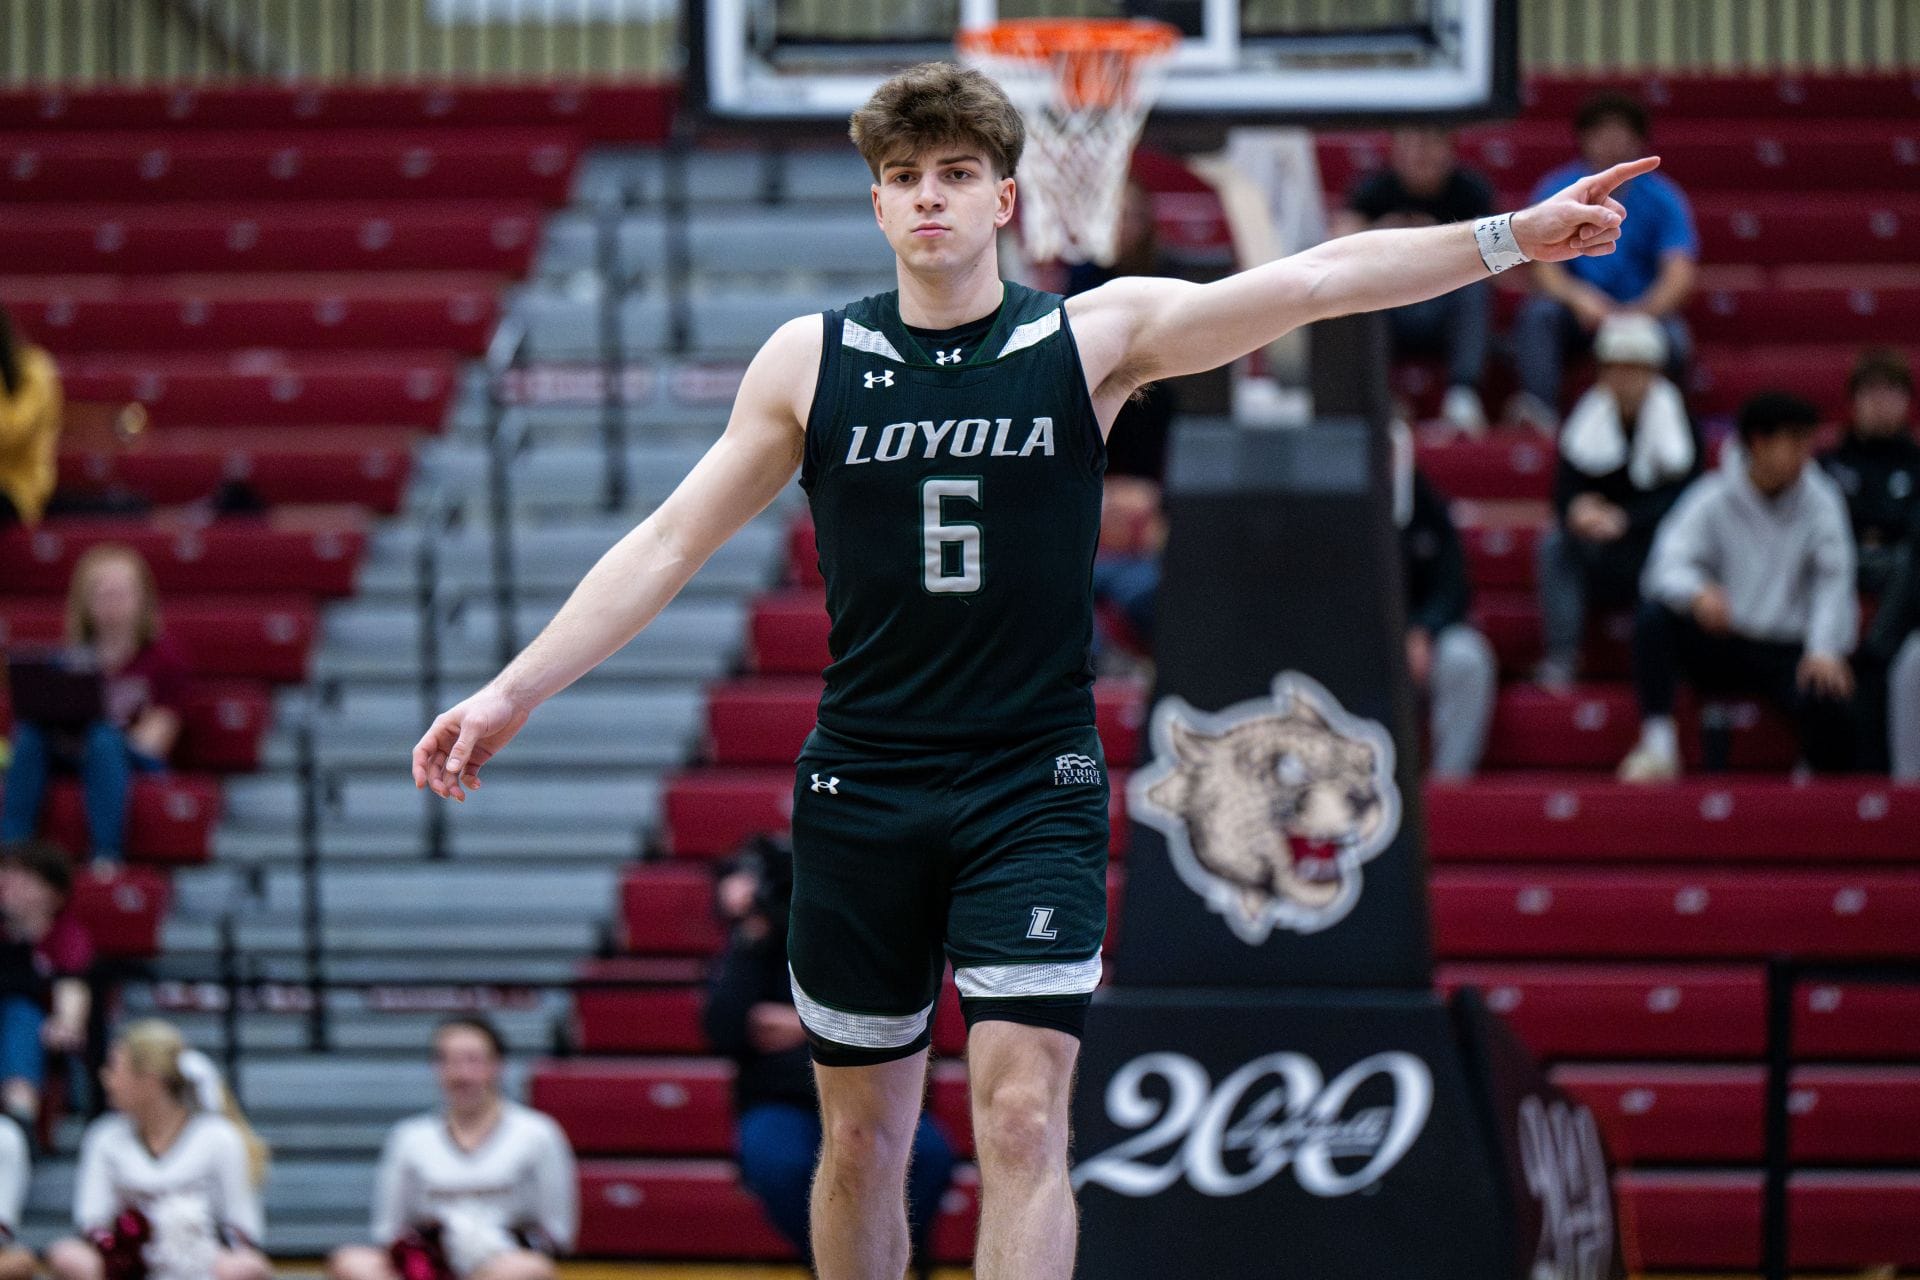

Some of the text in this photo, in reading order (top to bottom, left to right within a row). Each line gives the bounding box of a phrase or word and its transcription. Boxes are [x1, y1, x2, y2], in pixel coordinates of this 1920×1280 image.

[845, 417, 1055, 465] LOYOLA
[923, 477, 983, 595] 6
[1053, 768, 1101, 778] PATRIOT
[1054, 776, 1102, 786] LEAGUE
[1026, 906, 1058, 940] L
[1070, 1050, 1435, 1198] 200
